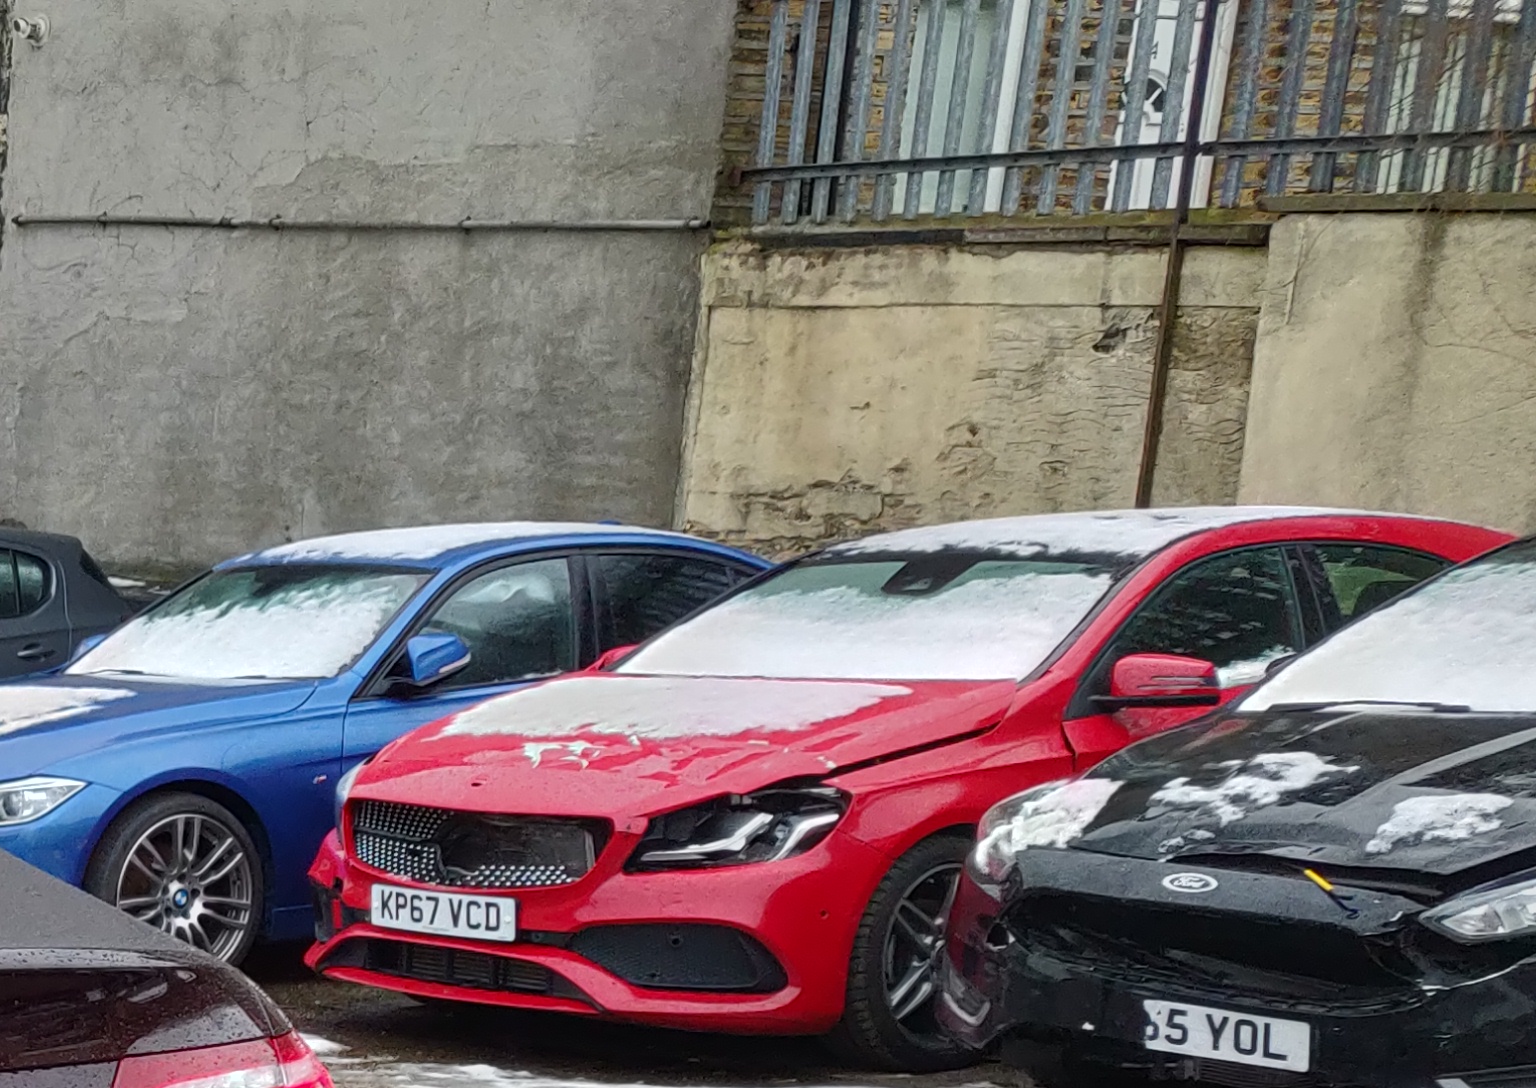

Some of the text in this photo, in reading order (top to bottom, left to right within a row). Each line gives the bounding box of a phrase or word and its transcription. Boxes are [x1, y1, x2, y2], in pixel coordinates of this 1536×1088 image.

[381, 889, 501, 932] KP67 VCD
[1205, 1013, 1289, 1062] YOL
